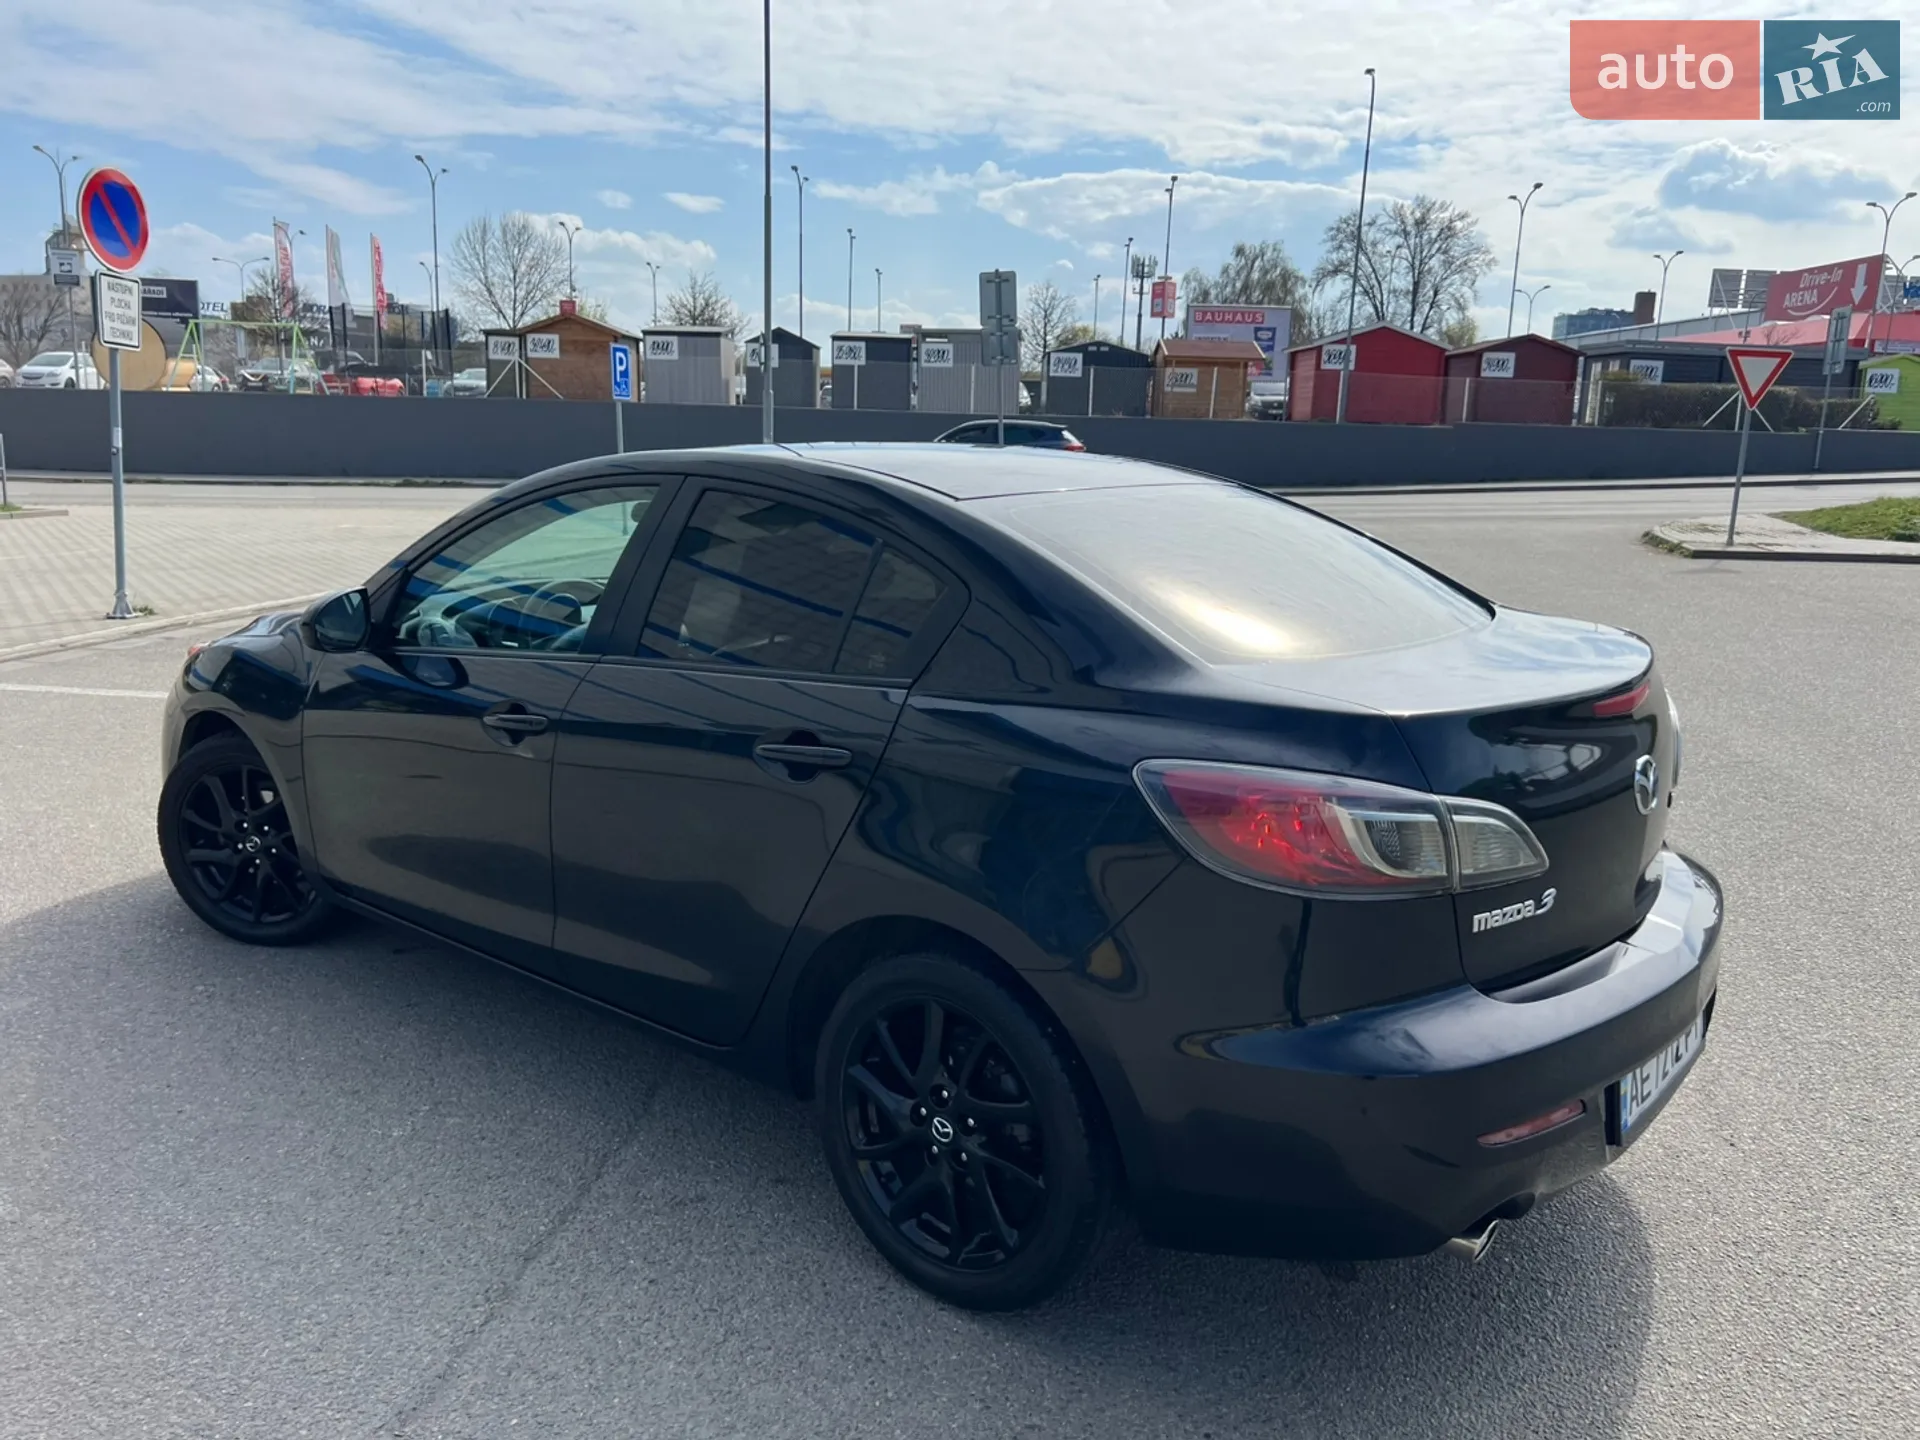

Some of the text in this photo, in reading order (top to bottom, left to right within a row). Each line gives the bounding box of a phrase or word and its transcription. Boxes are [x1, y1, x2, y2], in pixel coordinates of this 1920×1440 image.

[1799, 266, 1843, 288] Drive-In
[1783, 288, 1818, 308] ARENA
[1195, 311, 1263, 323] BAUHAUS
[615, 351, 627, 383] P
[1629, 1065, 1652, 1116] AE
